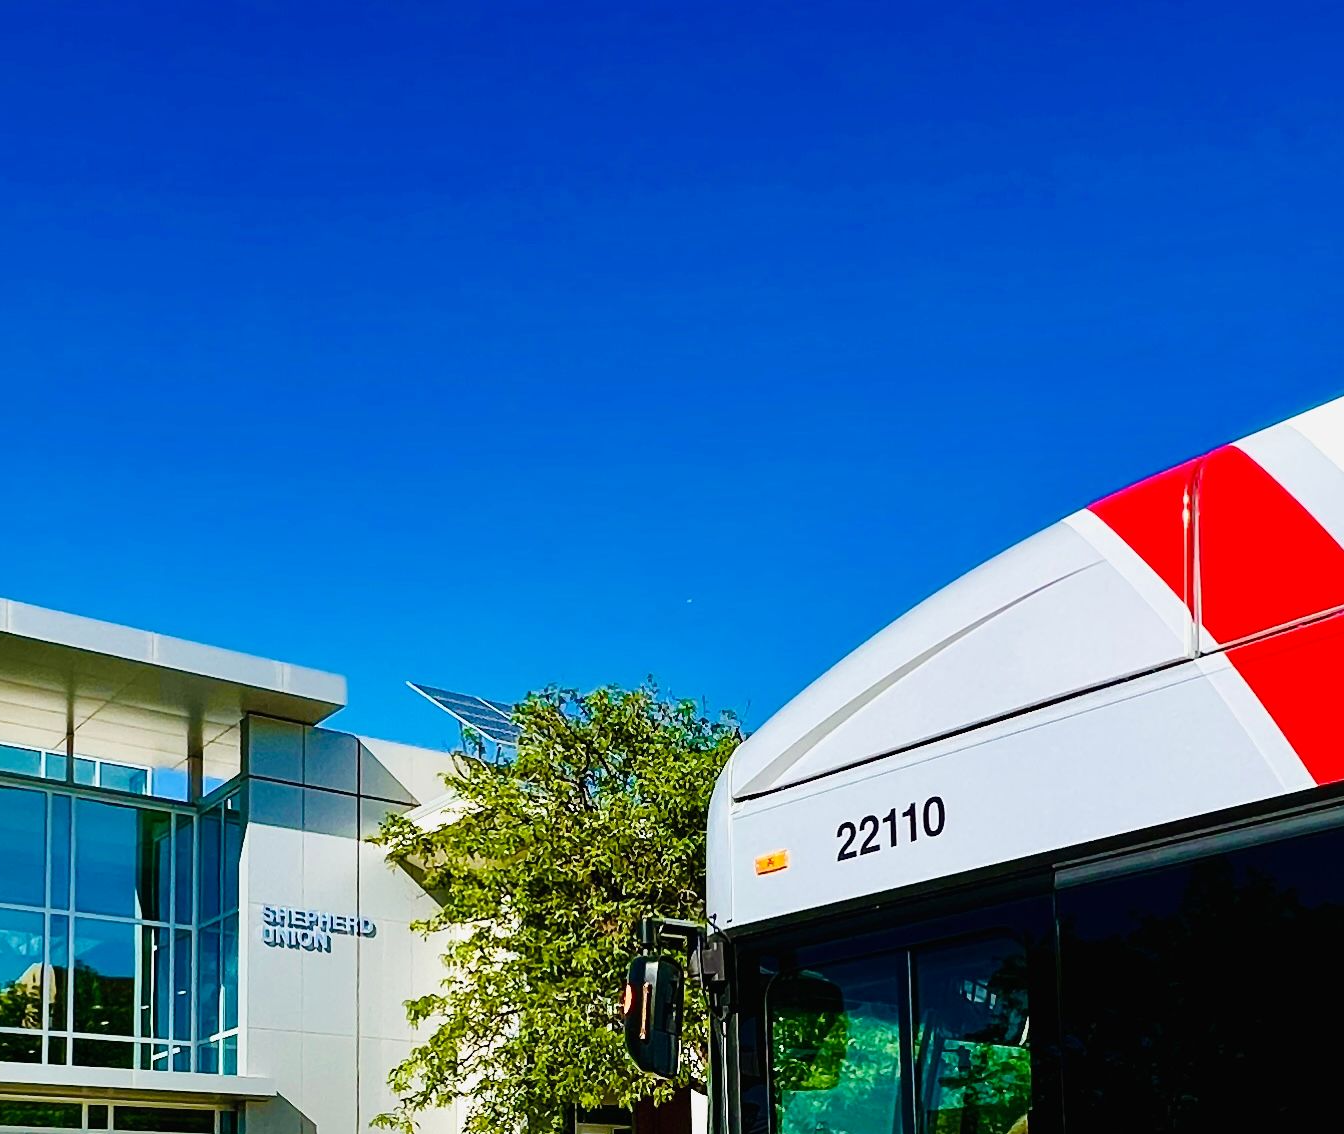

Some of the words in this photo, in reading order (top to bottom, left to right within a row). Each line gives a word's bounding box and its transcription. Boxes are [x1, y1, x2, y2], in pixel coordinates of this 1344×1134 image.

[836, 796, 946, 862] 22110
[261, 904, 376, 938] SHEPHERD
[261, 925, 332, 953] UNION
